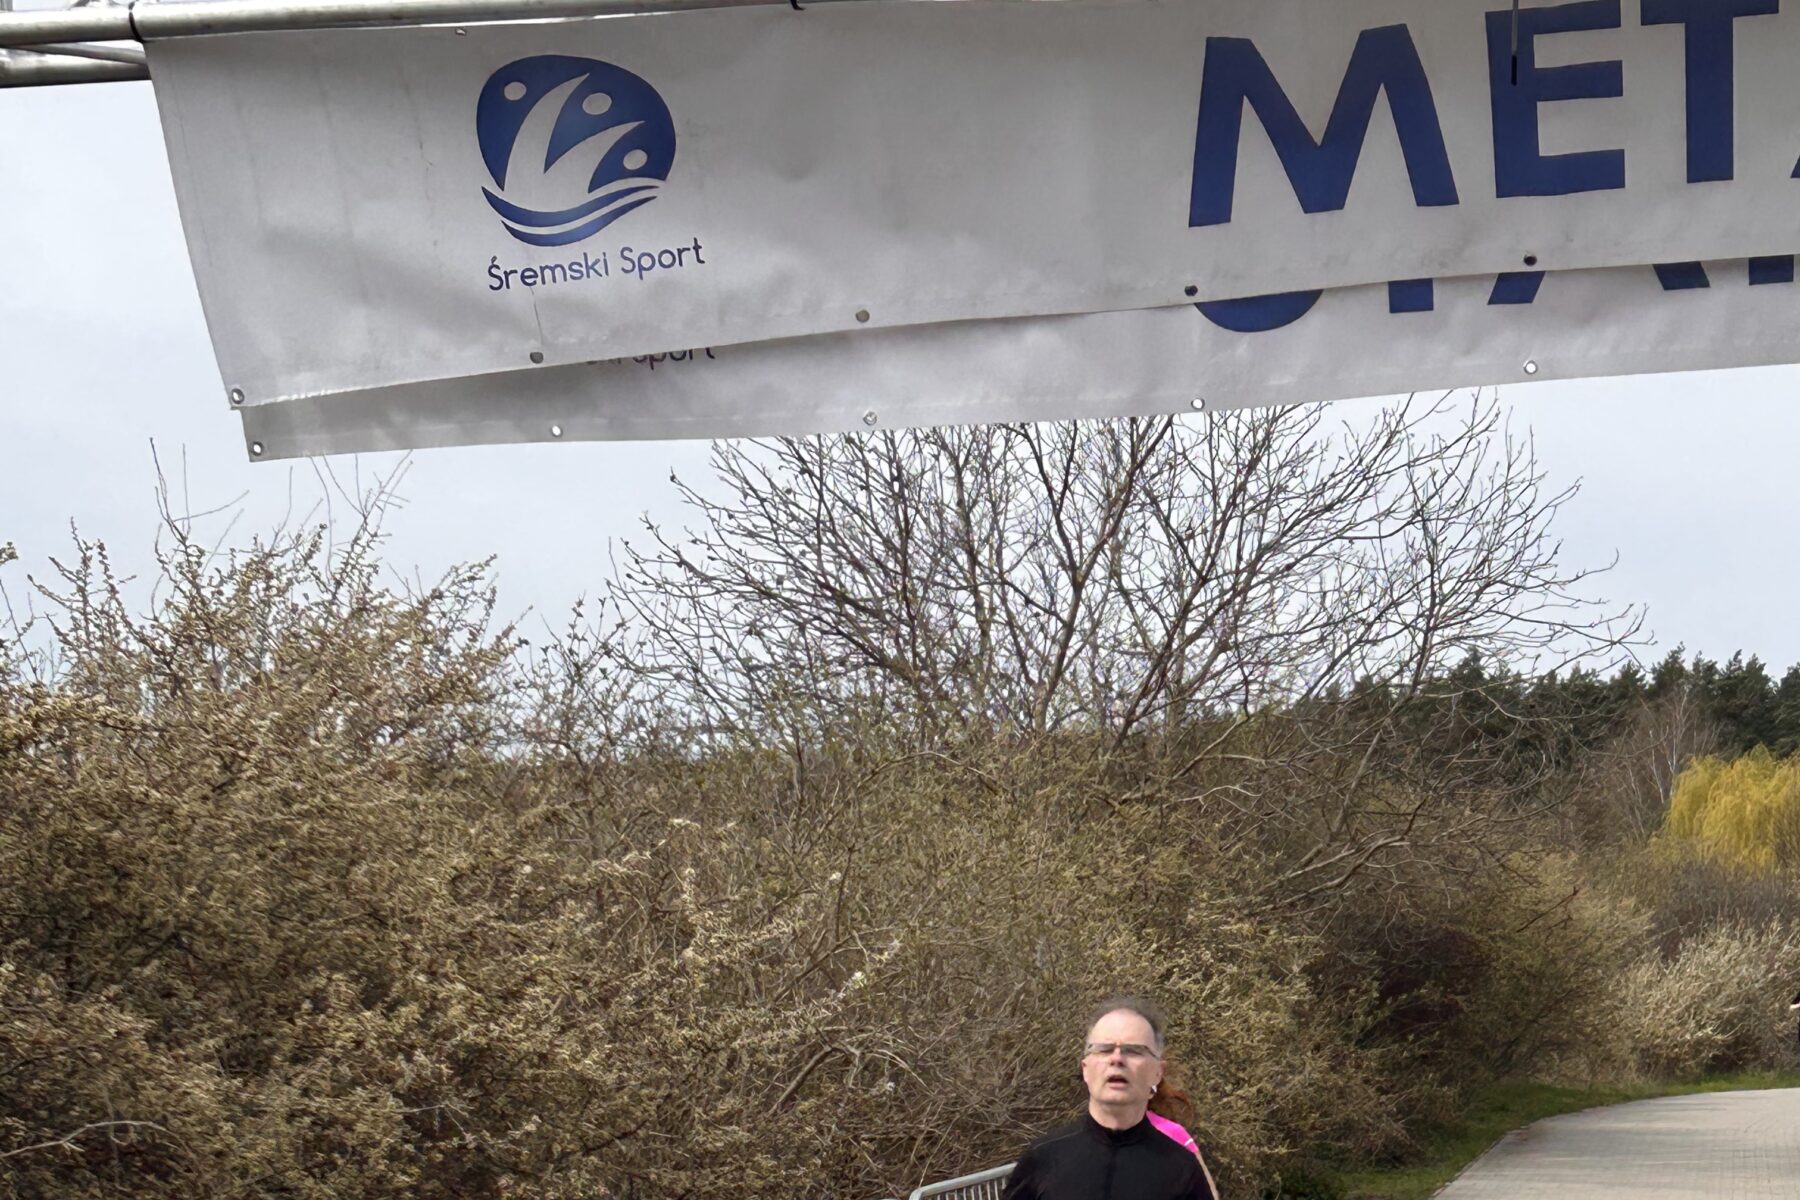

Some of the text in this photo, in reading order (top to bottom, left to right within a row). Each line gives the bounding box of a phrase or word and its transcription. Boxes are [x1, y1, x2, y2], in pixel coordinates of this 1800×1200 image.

[1189, 0, 1800, 227] MET
[487, 237, 706, 291] Śremski Sport
